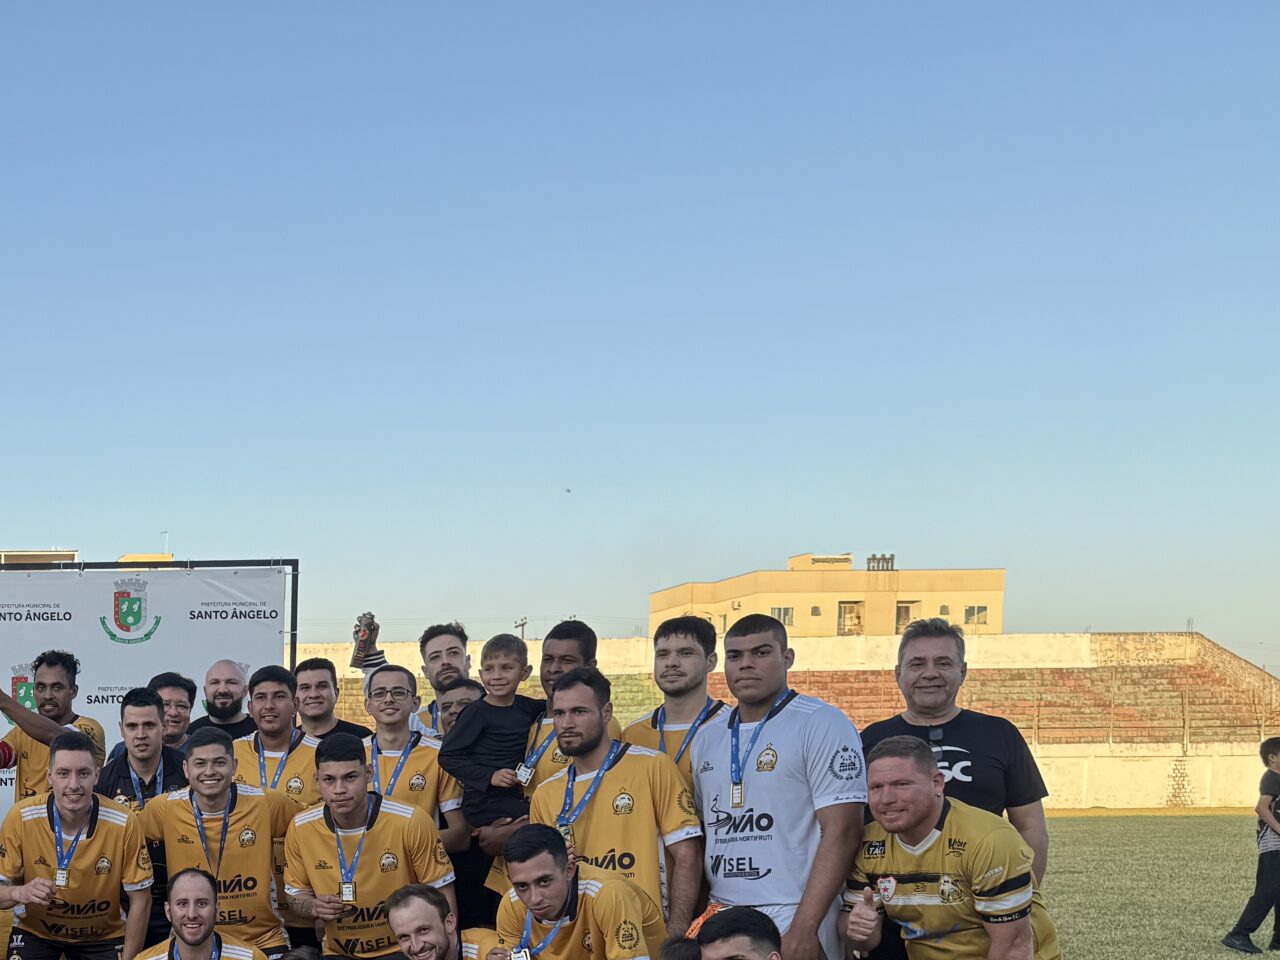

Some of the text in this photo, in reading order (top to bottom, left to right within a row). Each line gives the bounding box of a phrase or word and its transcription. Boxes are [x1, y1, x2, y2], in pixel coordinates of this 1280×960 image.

[24, 610, 72, 621] ÂNGELO
[189, 608, 279, 620] SANTO ÂNGELO
[86, 694, 125, 704] SANTO
